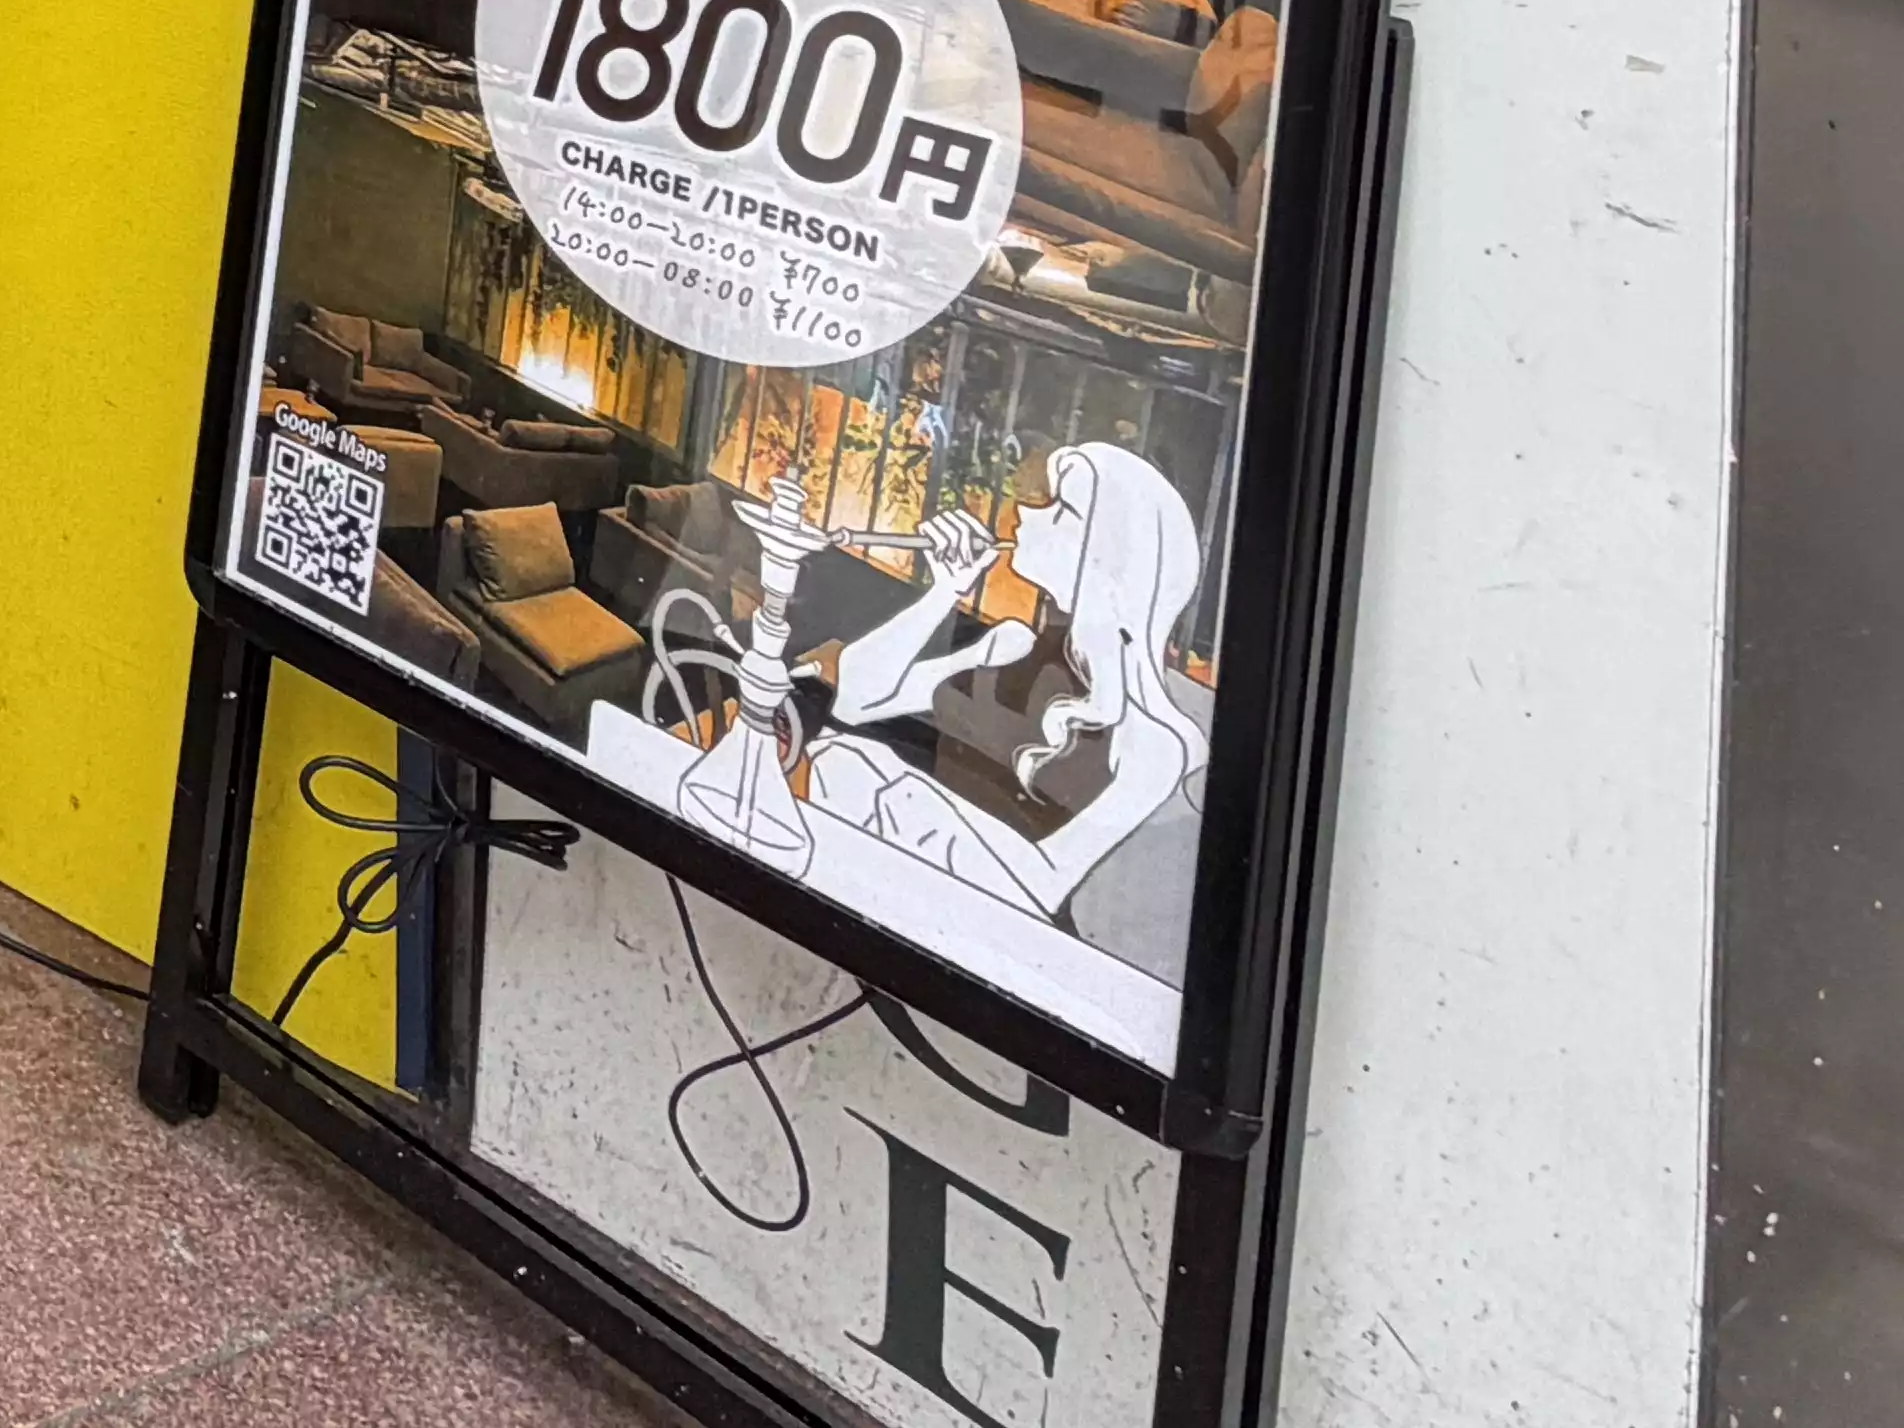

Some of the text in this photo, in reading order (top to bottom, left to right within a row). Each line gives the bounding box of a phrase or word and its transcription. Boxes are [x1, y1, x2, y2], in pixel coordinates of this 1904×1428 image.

[561, 140, 692, 202] CHARGE
[275, 403, 387, 472] Google Maps
